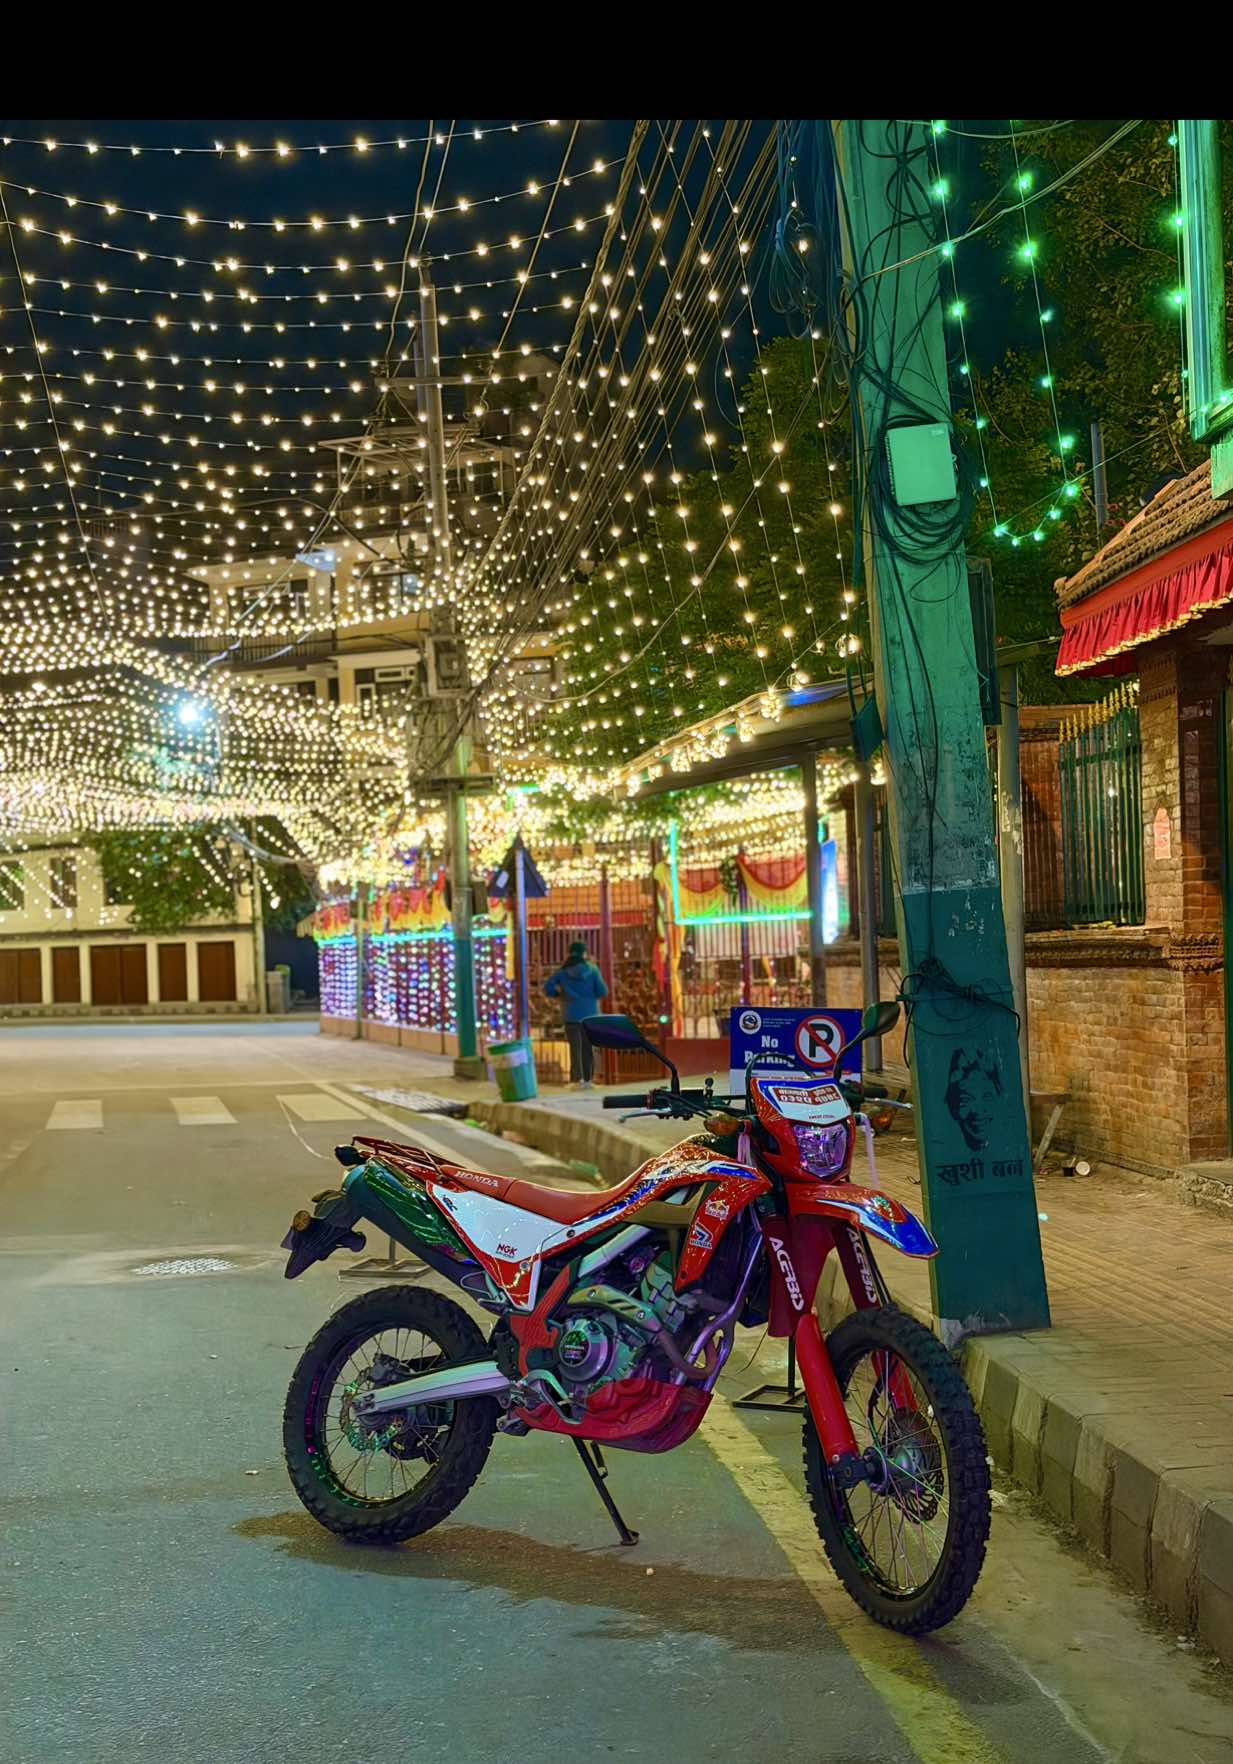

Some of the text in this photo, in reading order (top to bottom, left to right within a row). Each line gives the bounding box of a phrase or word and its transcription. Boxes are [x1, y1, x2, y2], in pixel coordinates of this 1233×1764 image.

[761, 1035, 779, 1048] No
[454, 1170, 499, 1188] HONDA
[497, 1243, 518, 1256] NGK
